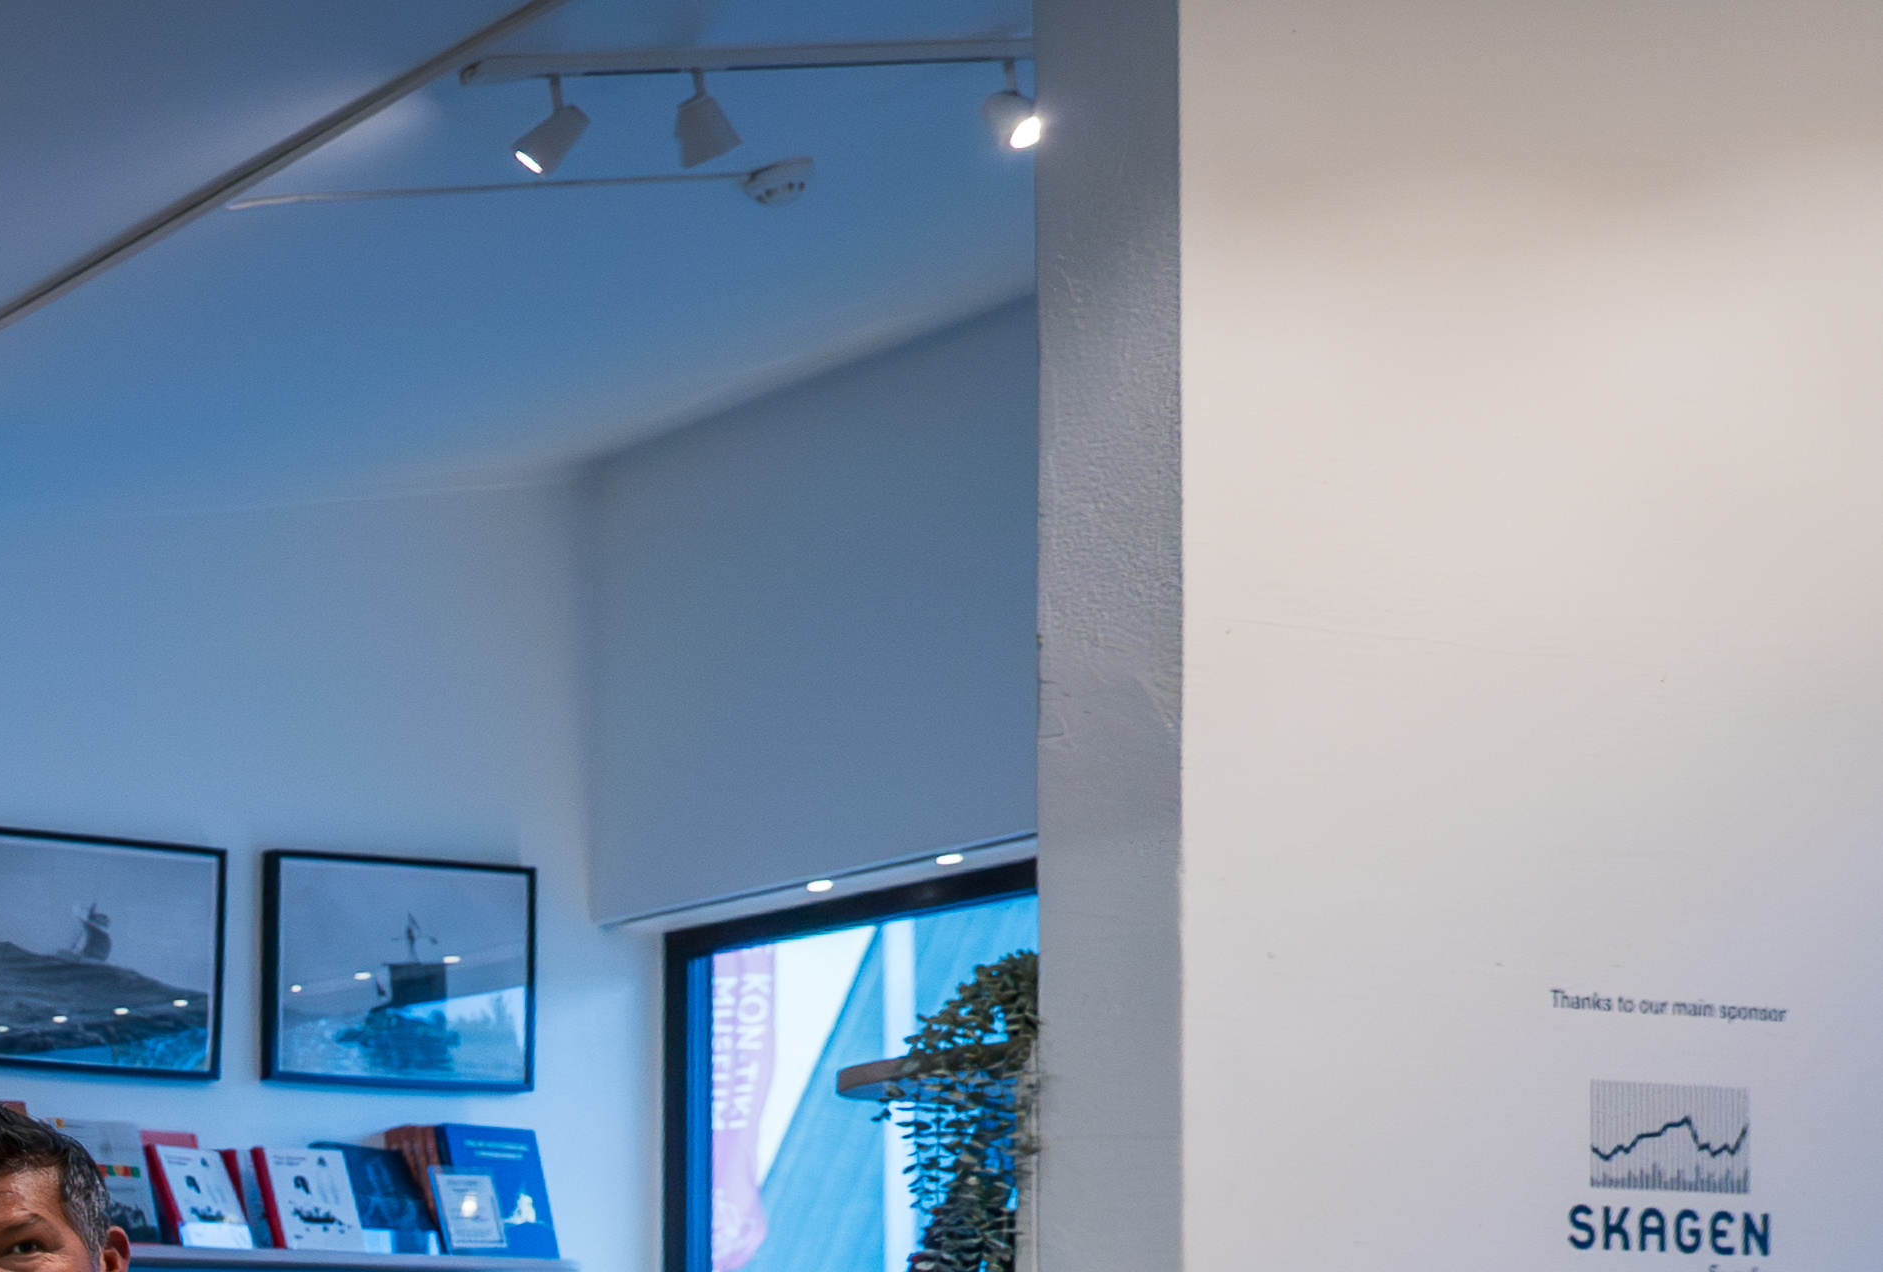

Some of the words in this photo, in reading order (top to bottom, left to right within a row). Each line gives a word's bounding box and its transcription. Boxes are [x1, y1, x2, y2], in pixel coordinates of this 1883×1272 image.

[1550, 988, 1613, 1012] Thanks
[1617, 996, 1635, 1013] to
[1638, 999, 1668, 1015] our
[1672, 1000, 1715, 1017] main
[1718, 1004, 1788, 1023] sponsor
[1567, 1204, 1773, 1258] SKAGEN
